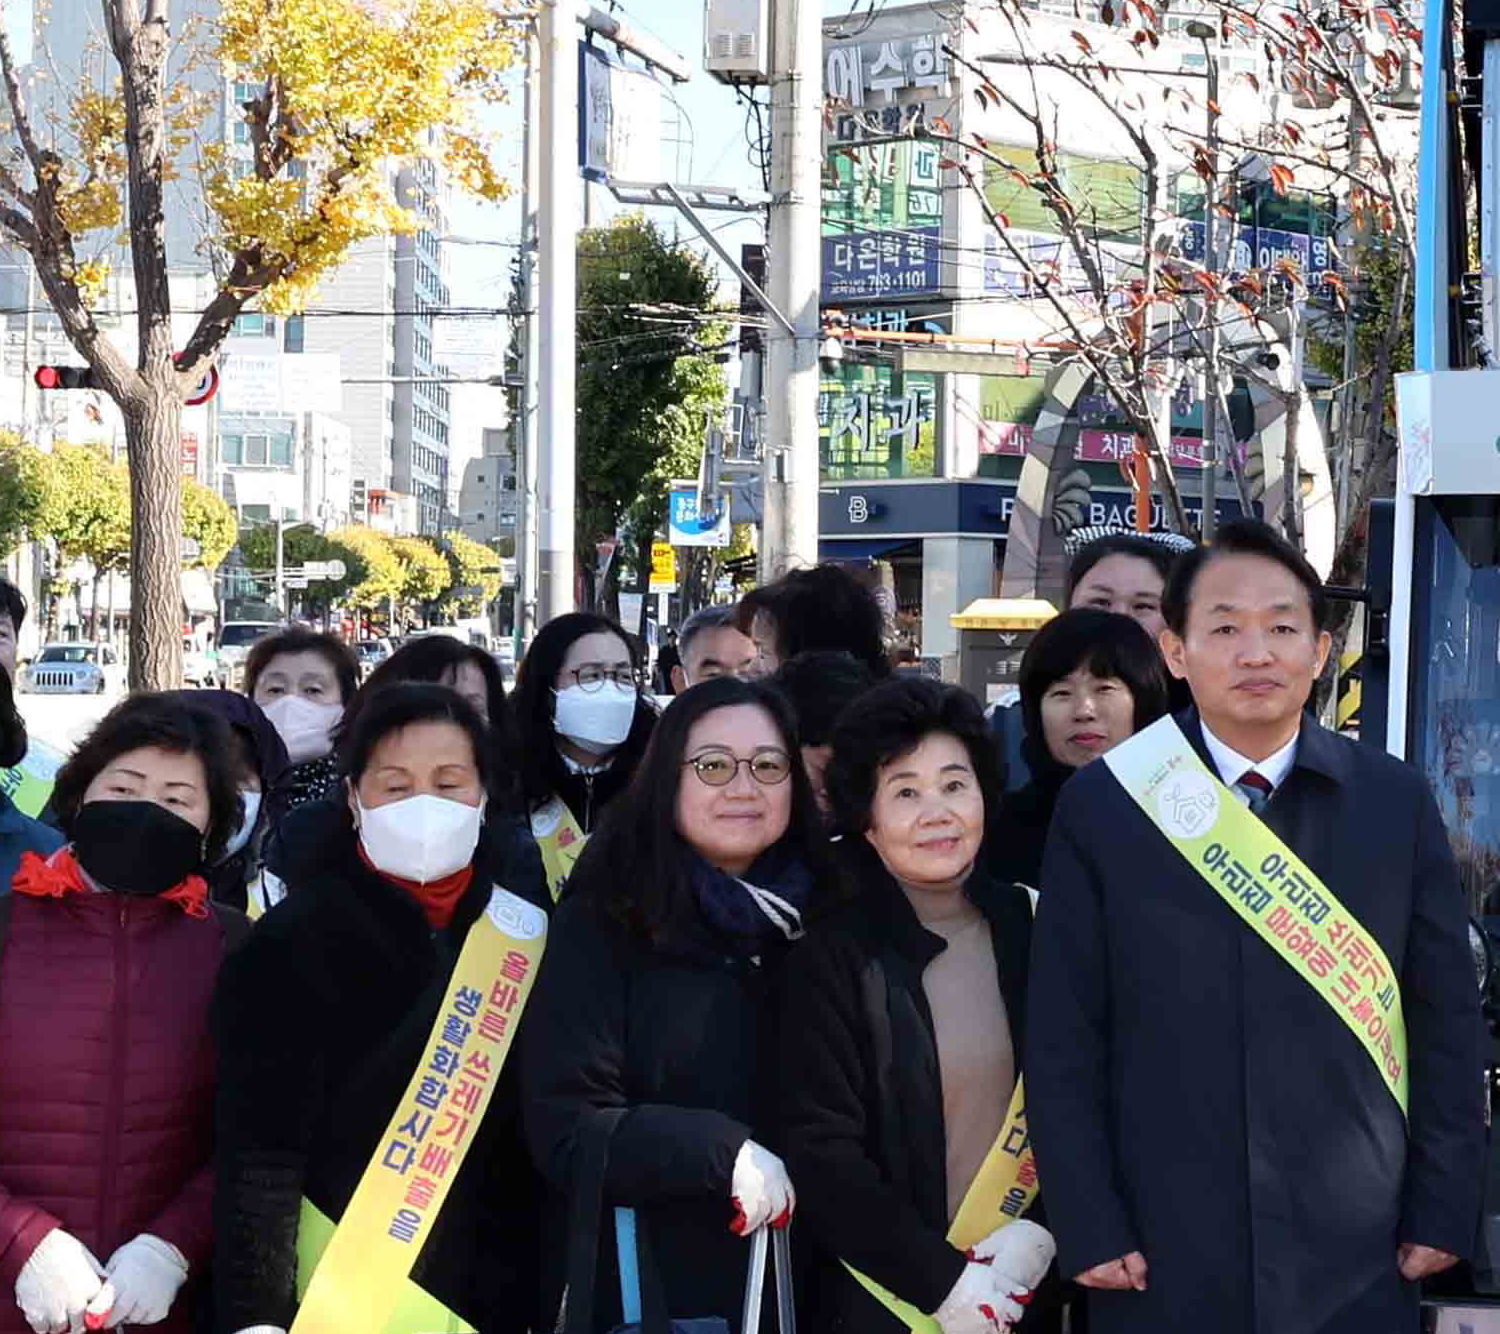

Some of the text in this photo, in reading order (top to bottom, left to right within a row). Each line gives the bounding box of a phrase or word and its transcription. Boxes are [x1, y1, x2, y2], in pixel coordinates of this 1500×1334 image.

[834, 233, 926, 273] 다온학원
[1201, 841, 1271, 914] 우리집
[1266, 907, 1335, 979] 문앞에
[1259, 852, 1331, 926] 우리집
[380, 985, 484, 1177] 생활화합시다
[388, 949, 532, 1245] 올바른 쓰레기배출을
